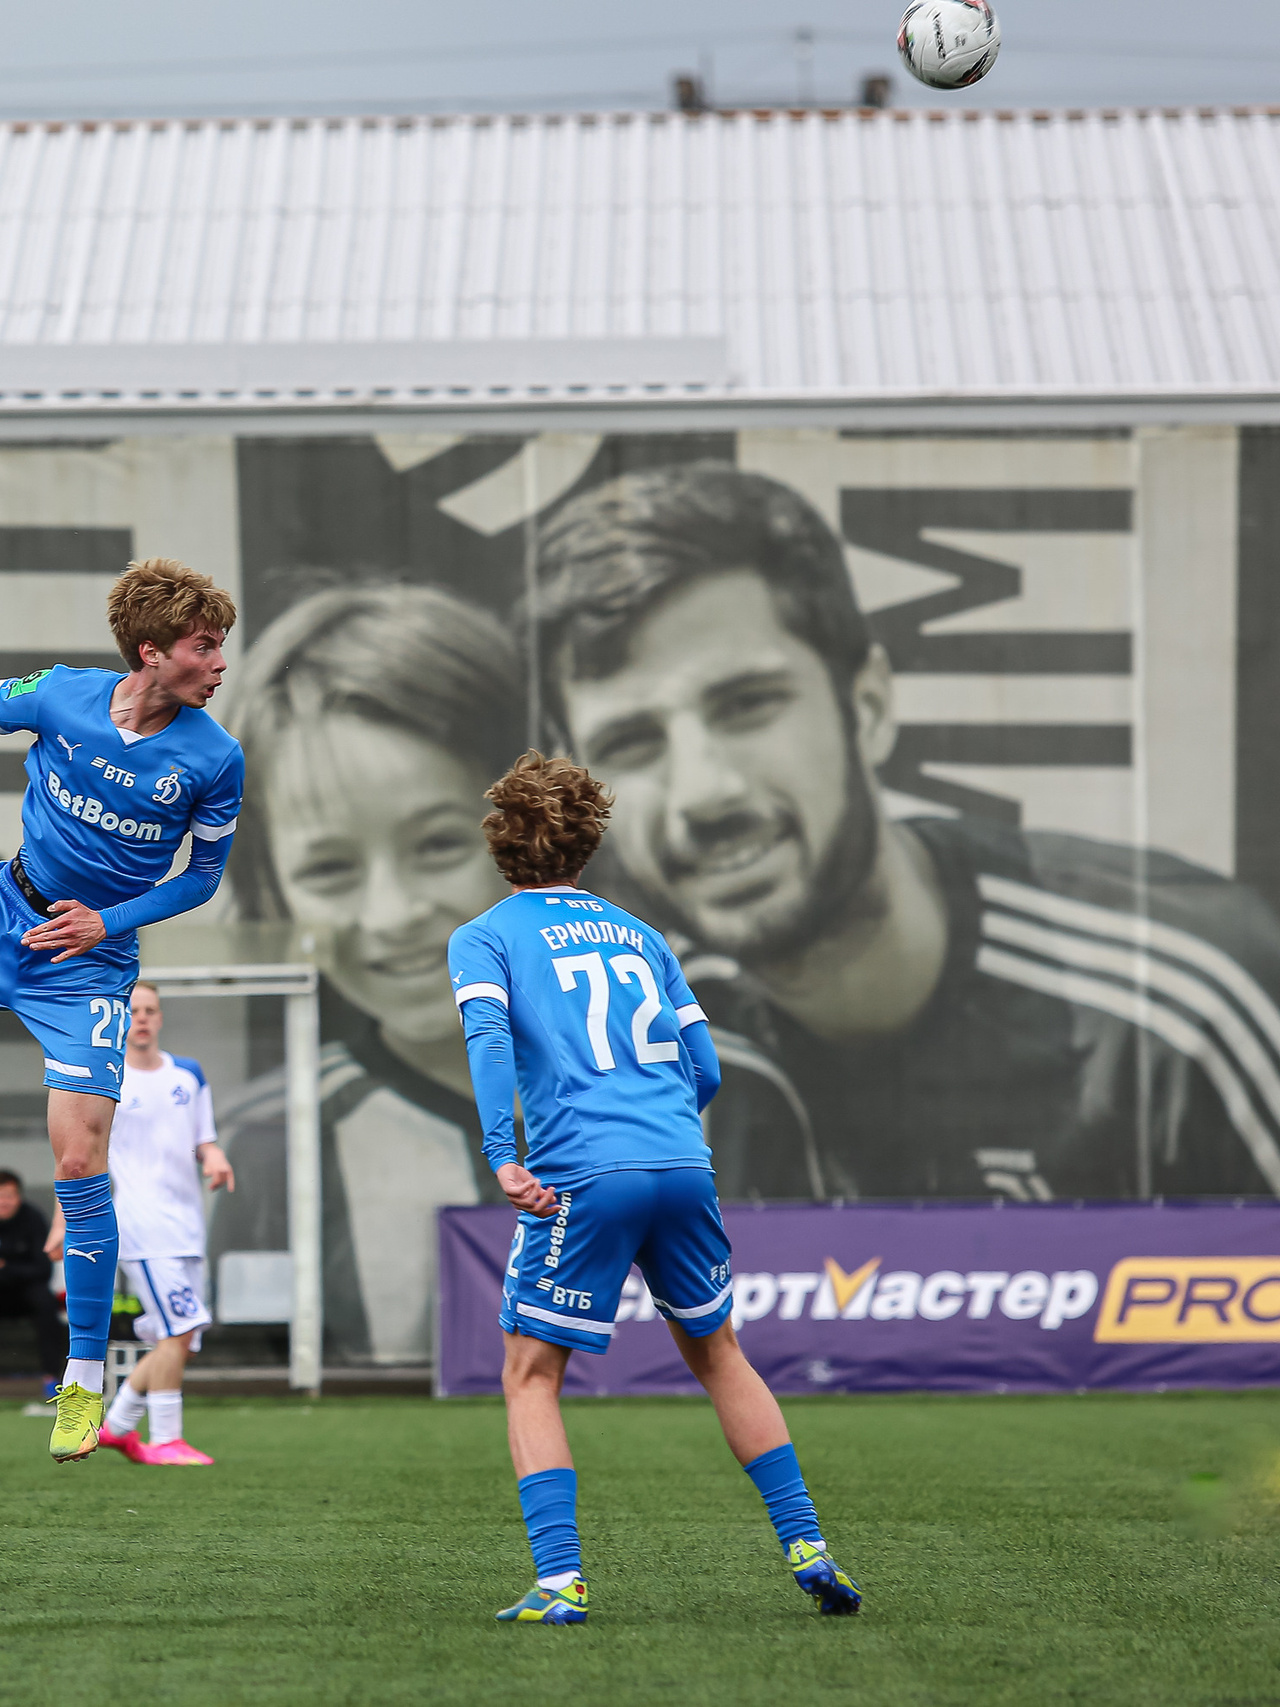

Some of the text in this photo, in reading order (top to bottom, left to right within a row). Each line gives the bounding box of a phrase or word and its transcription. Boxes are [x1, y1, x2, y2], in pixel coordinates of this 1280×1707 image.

[103, 764, 137, 788] ВТБ
[48, 770, 162, 841] BetBoom
[563, 899, 604, 912] ВТБ
[538, 920, 644, 953] ЕРМОЛИН
[89, 997, 126, 1050] 27
[551, 951, 680, 1071] 72
[544, 1192, 572, 1269] BetBoom
[552, 1285, 593, 1310] ВТБ
